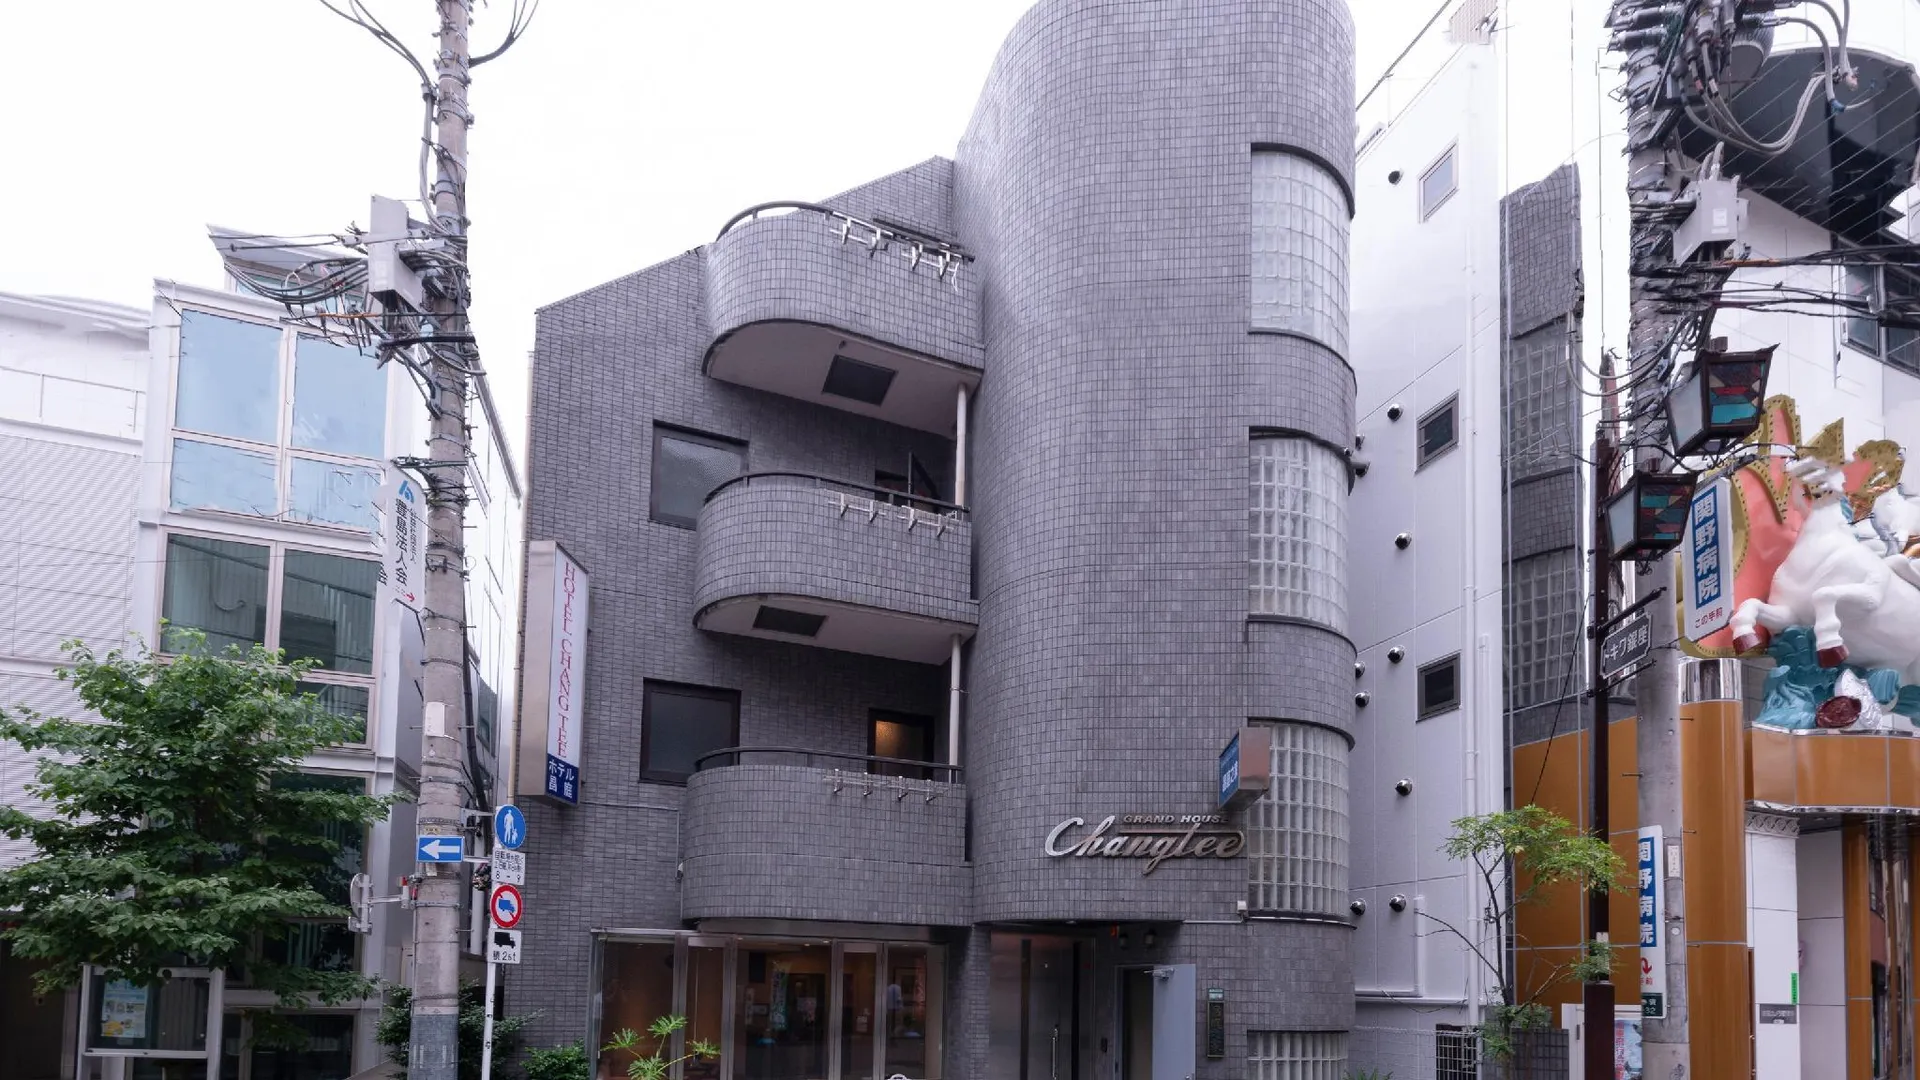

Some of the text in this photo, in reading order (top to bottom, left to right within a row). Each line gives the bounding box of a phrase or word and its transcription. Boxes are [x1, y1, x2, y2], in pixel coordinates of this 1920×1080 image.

[1694, 492, 1721, 604] 関野病院
[562, 561, 576, 636] HOTEL
[1693, 606, 1723, 628] この手前
[1603, 623, 1648, 661] トキワ銀座
[548, 759, 575, 781] ホテル
[1123, 814, 1175, 824] GRAND
